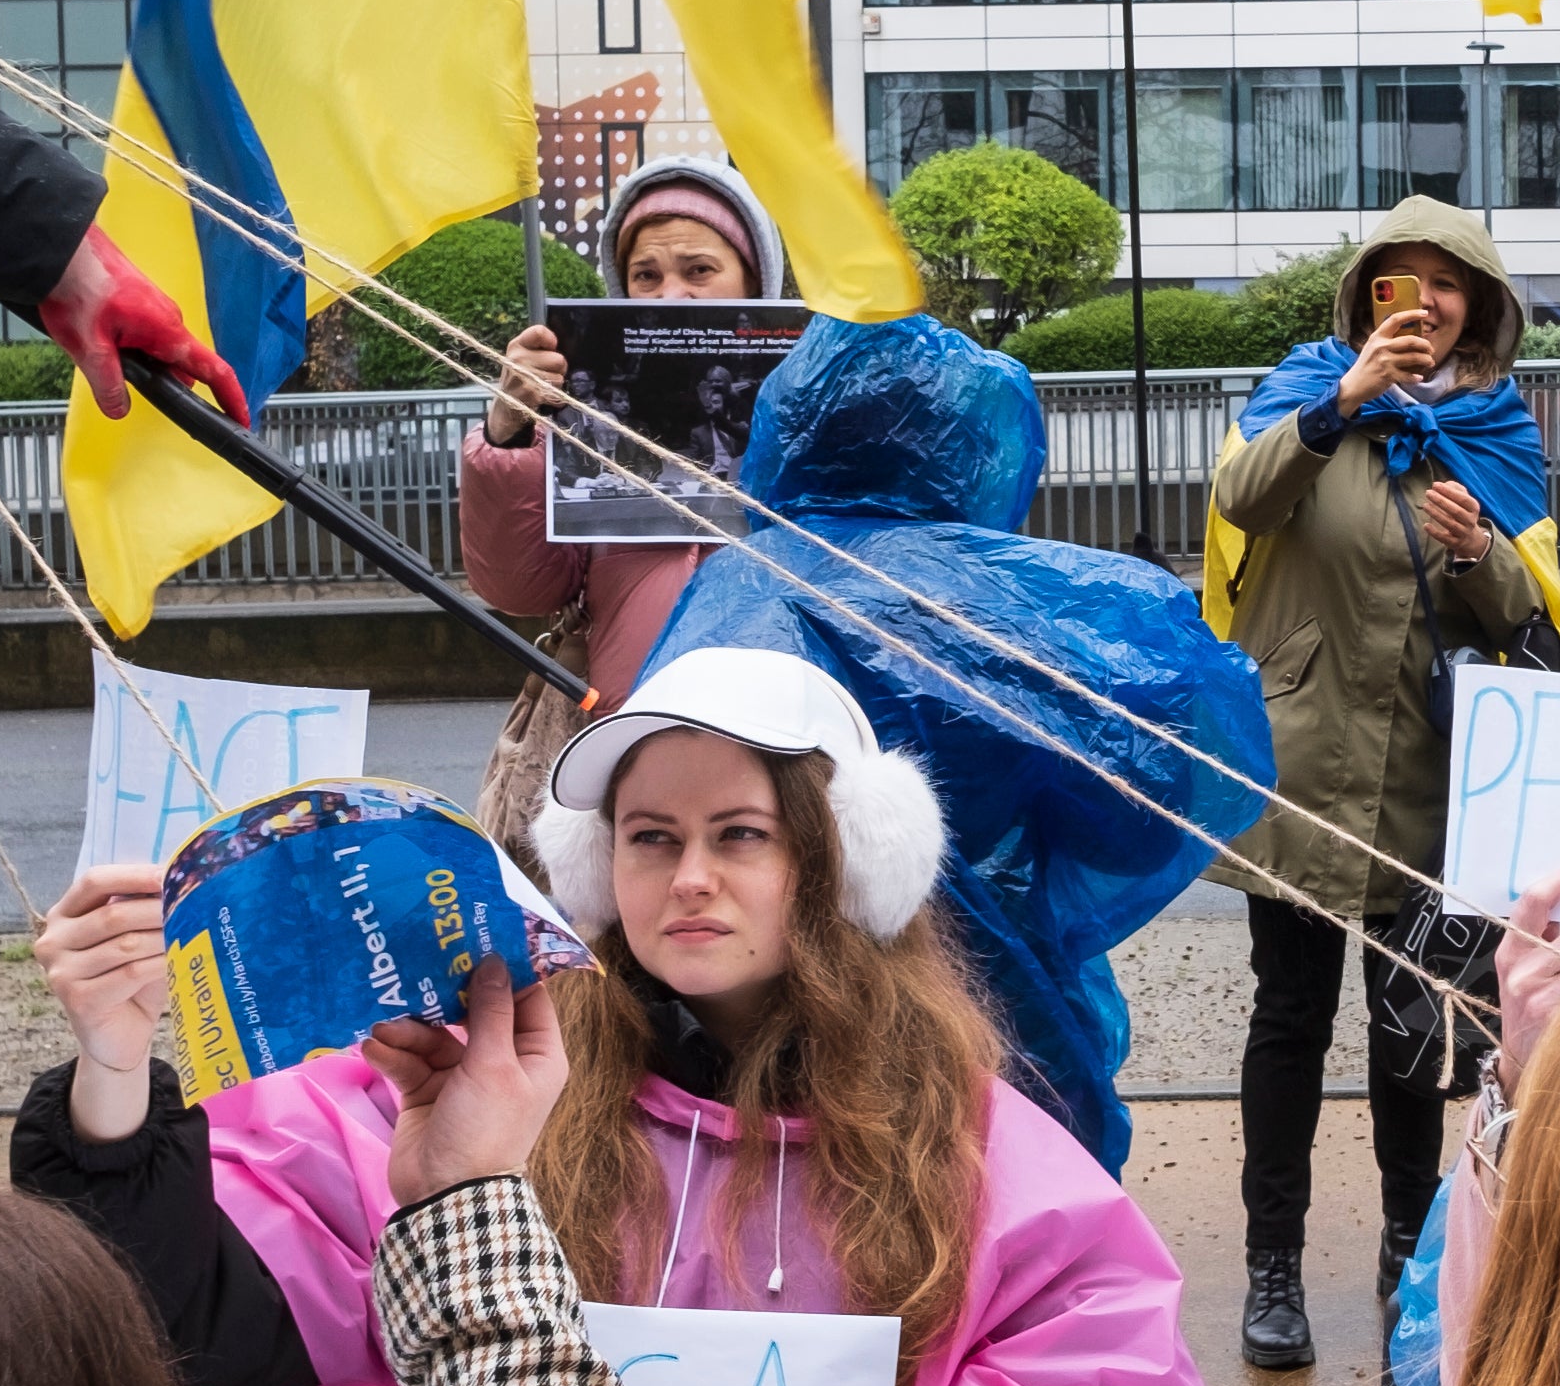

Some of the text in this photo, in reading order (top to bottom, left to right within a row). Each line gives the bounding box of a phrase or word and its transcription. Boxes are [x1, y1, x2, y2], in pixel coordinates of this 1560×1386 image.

[333, 845, 361, 862] 1
[352, 900, 408, 1007] Albert
[425, 869, 465, 950] 13:00
[473, 901, 489, 926] Rey
[189, 953, 227, 1060] l'Ukraine
[218, 906, 261, 1025] bit.ly/March25Feb
